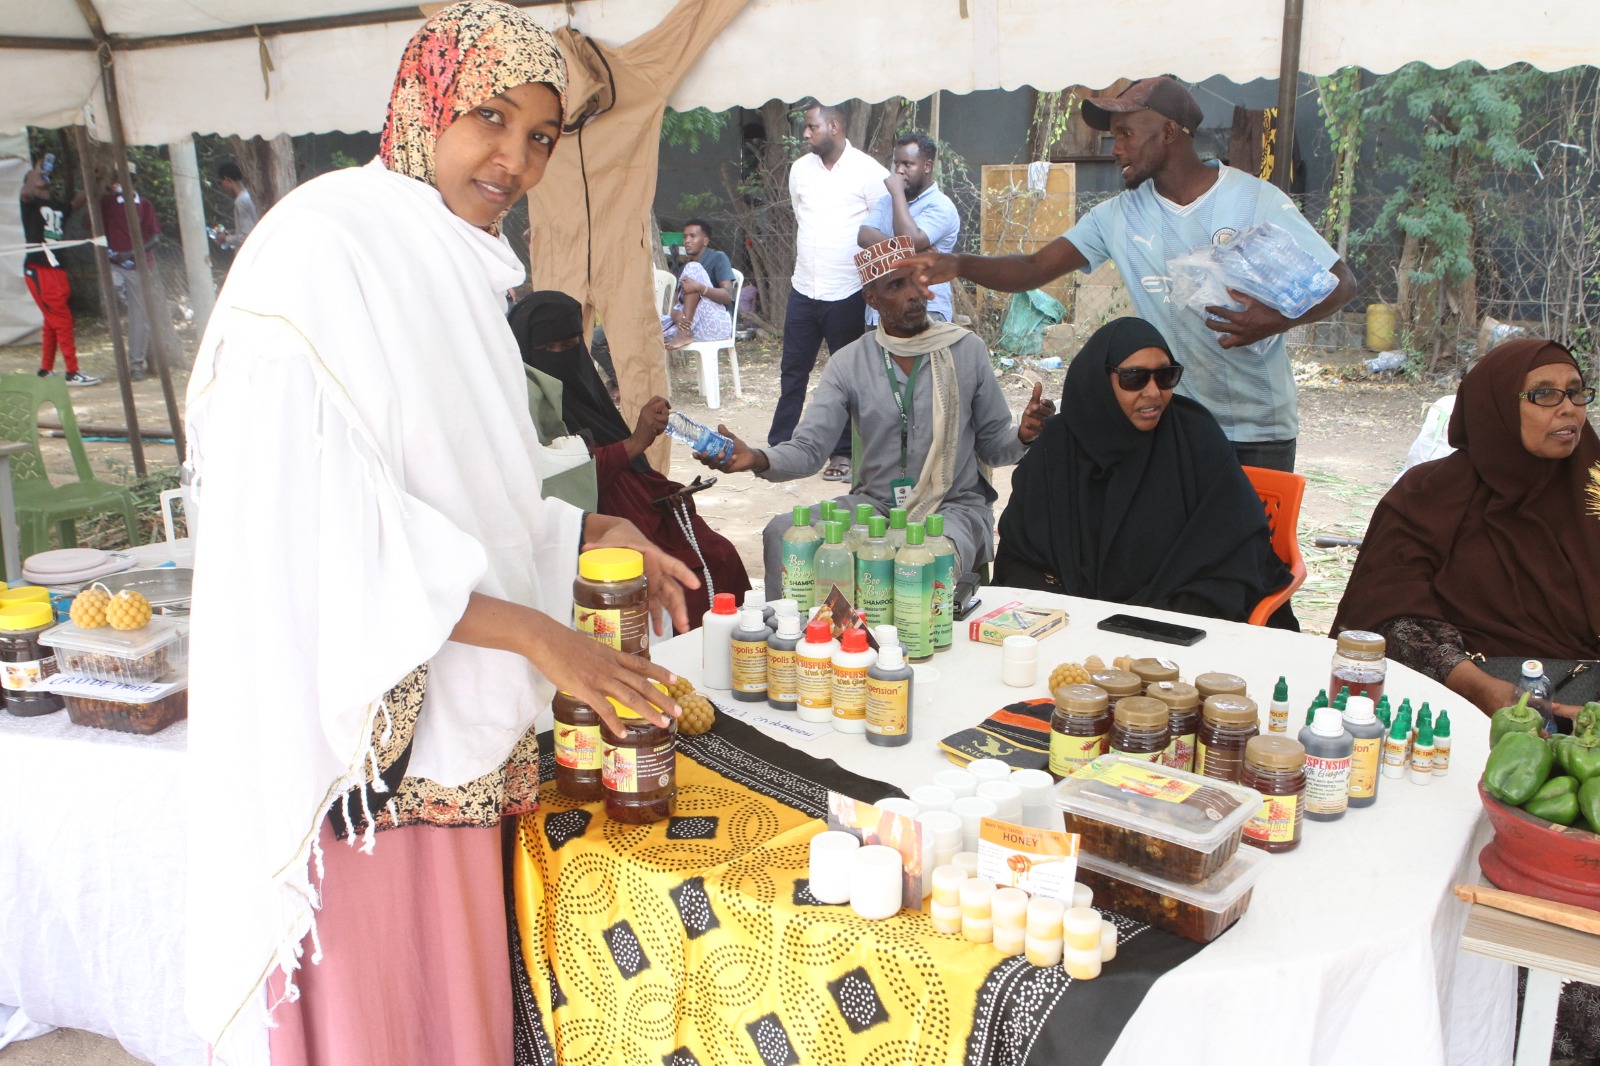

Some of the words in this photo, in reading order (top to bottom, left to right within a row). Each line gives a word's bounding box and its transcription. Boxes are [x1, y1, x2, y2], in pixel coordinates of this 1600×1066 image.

[800, 660, 832, 670] SUSPENS
[867, 684, 898, 696] pension
[1002, 832, 1040, 848] HONEY
